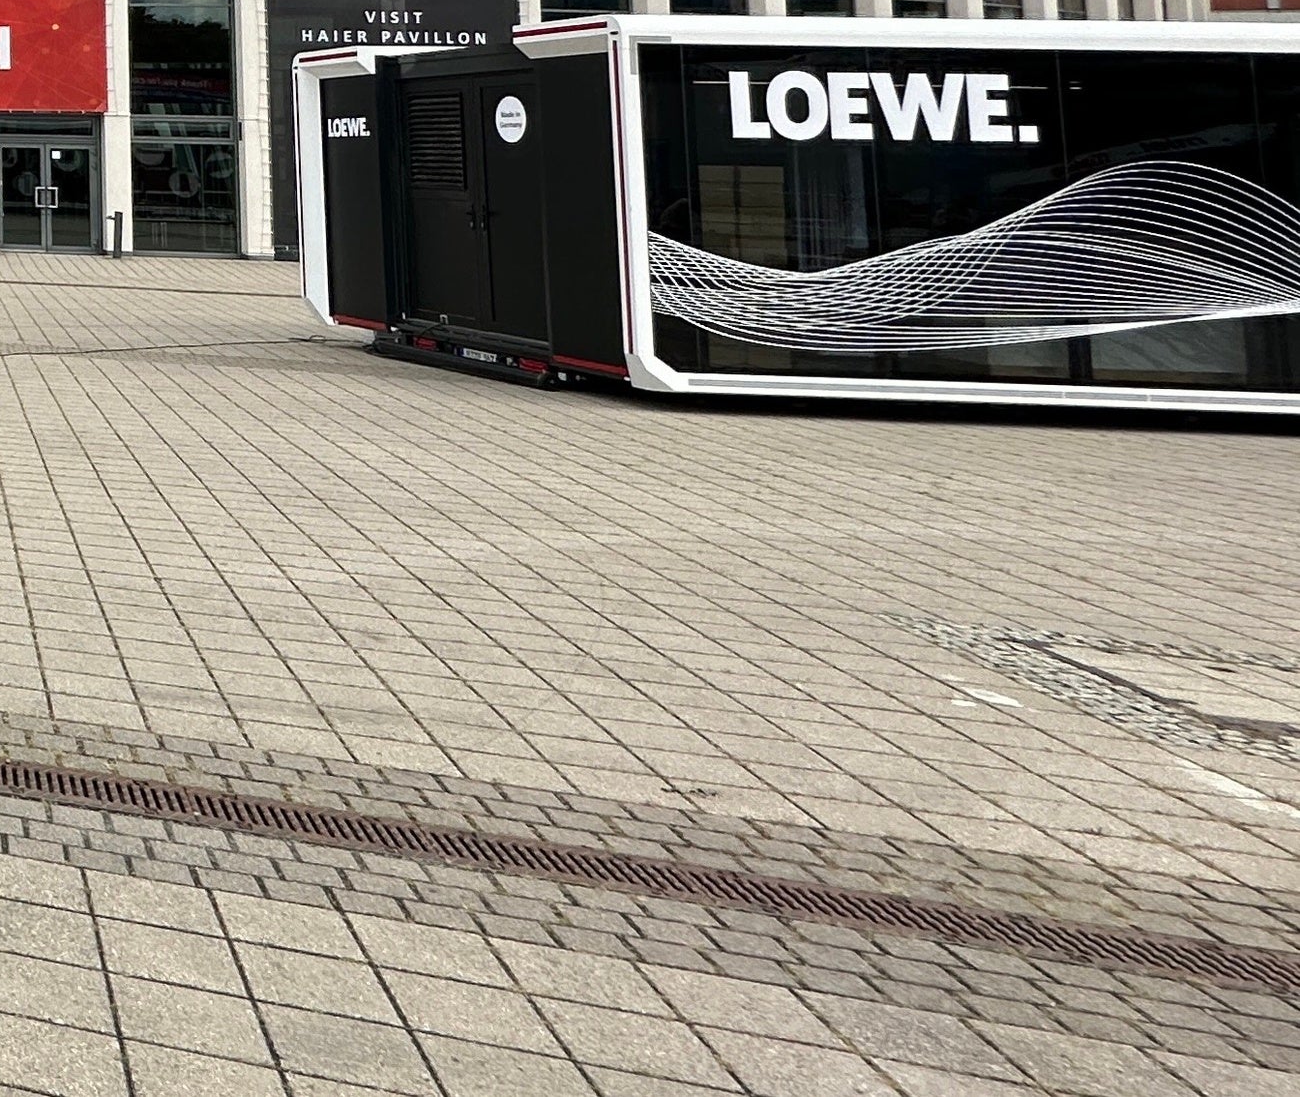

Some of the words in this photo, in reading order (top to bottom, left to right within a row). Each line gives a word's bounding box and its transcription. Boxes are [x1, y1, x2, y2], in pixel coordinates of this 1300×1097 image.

[364, 10, 423, 24] VISIT
[301, 29, 368, 43] HAIER
[381, 30, 487, 45] PAVILLON
[728, 69, 1040, 142] LOEWE.
[327, 117, 371, 138] LOEWE.
